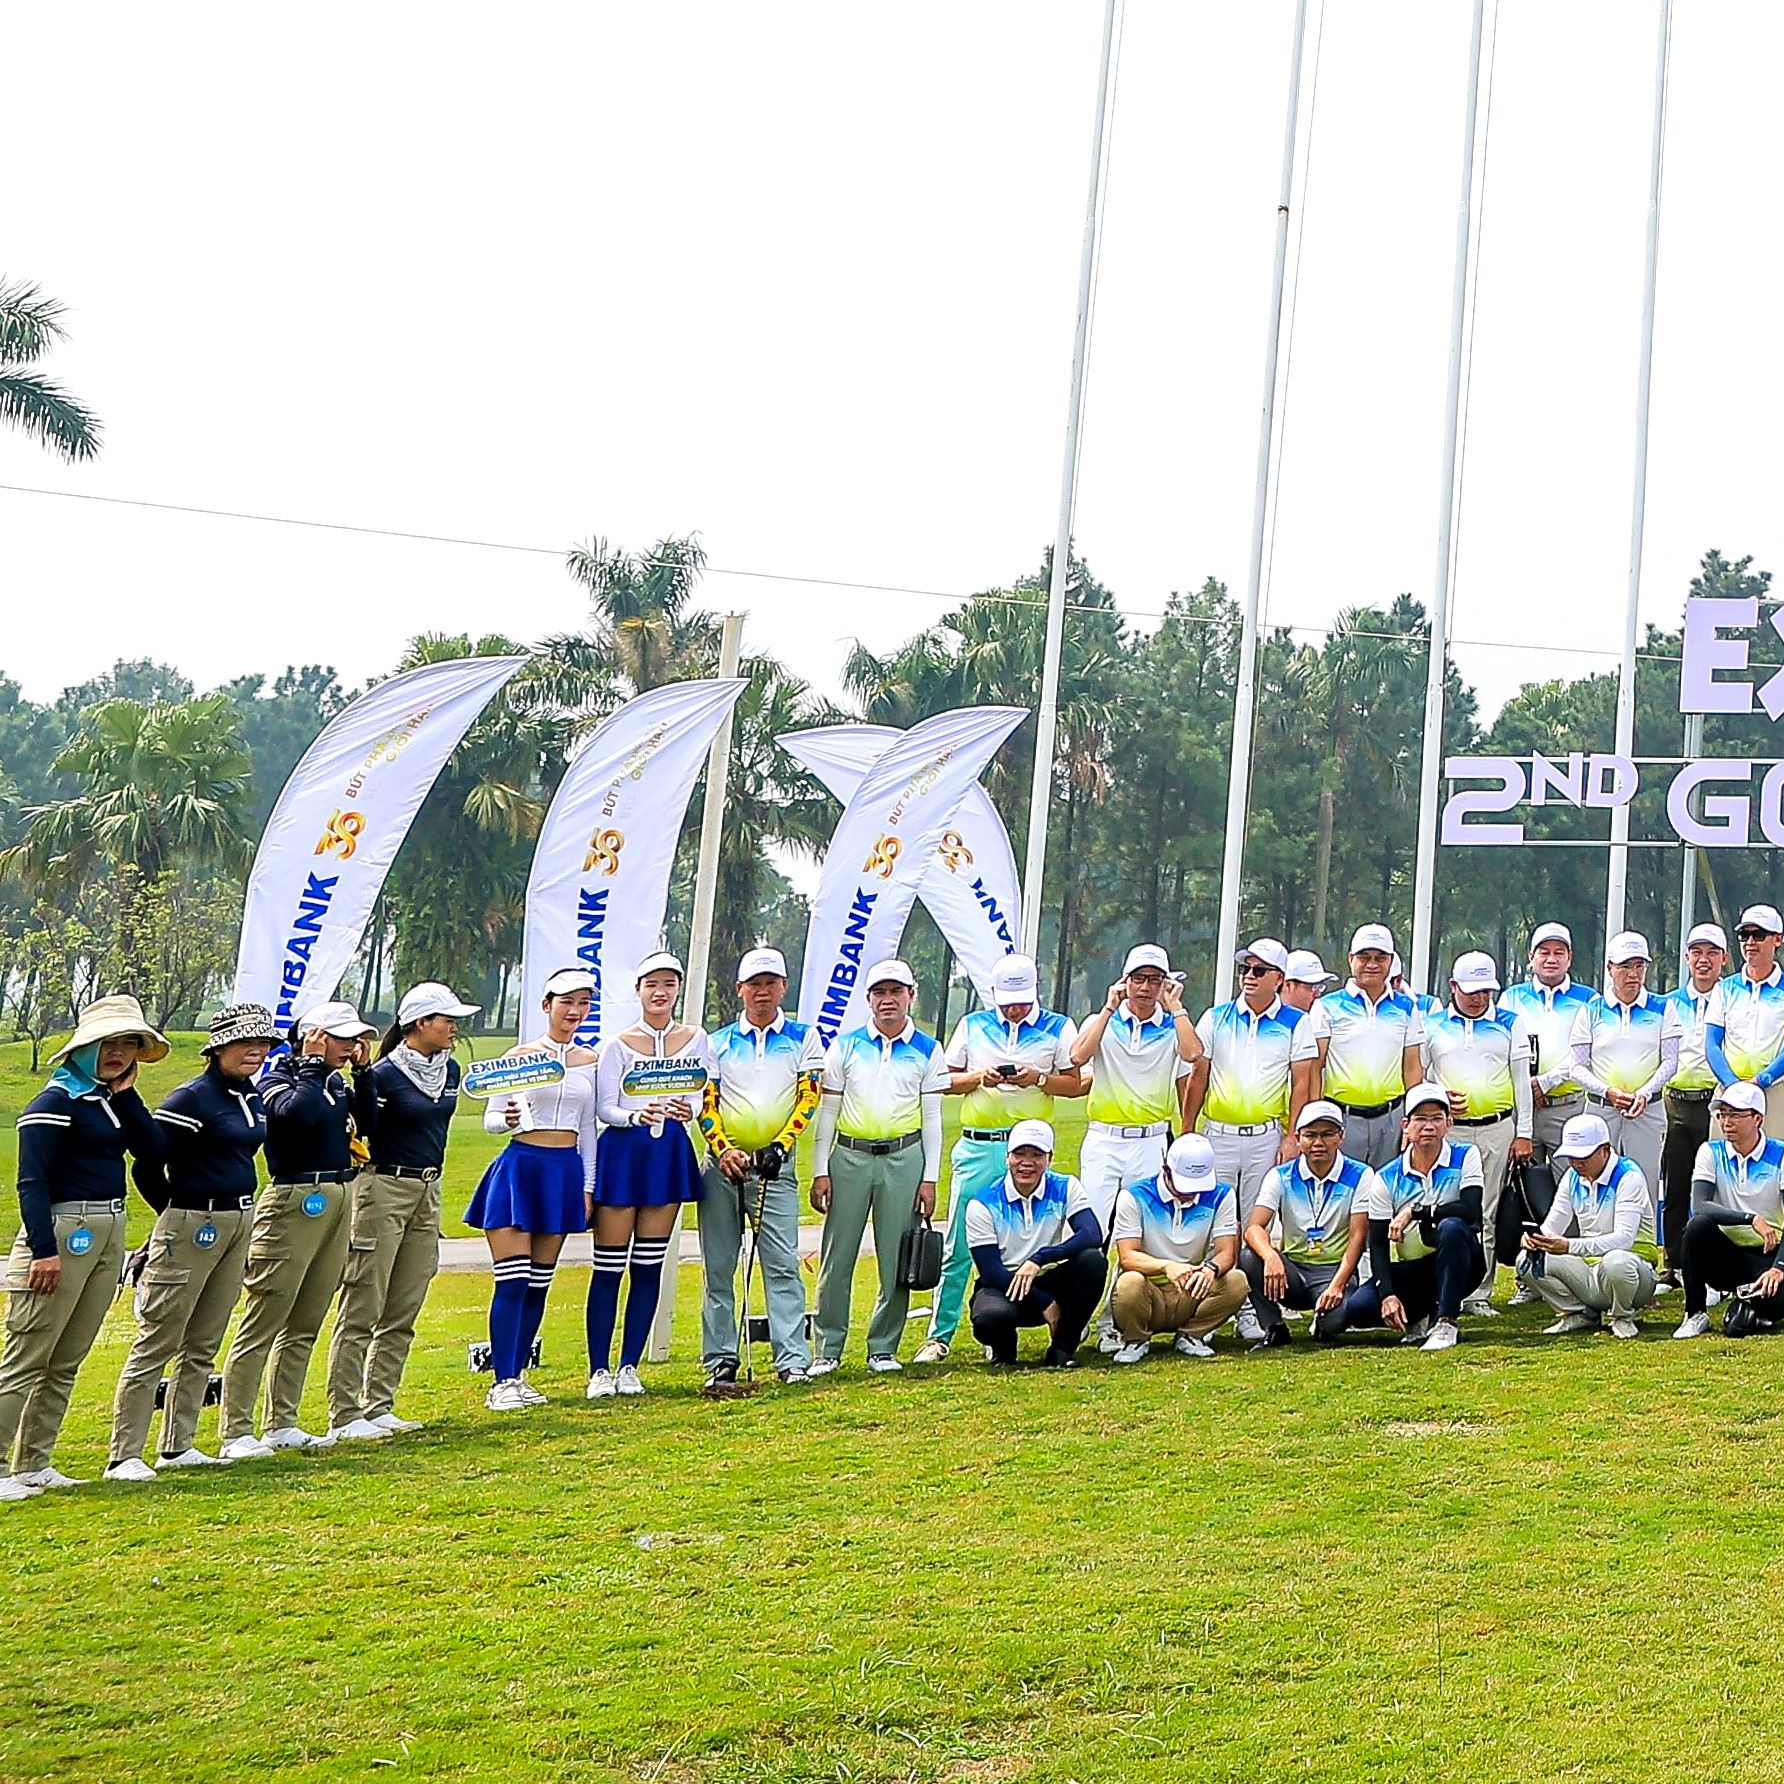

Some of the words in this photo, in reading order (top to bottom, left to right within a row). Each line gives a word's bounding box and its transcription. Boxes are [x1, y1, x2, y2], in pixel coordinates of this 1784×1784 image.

[1440, 750, 1638, 846] 2ND
[471, 1052, 550, 1074] EXIMBANK
[633, 1057, 700, 1071] EXIMBANK
